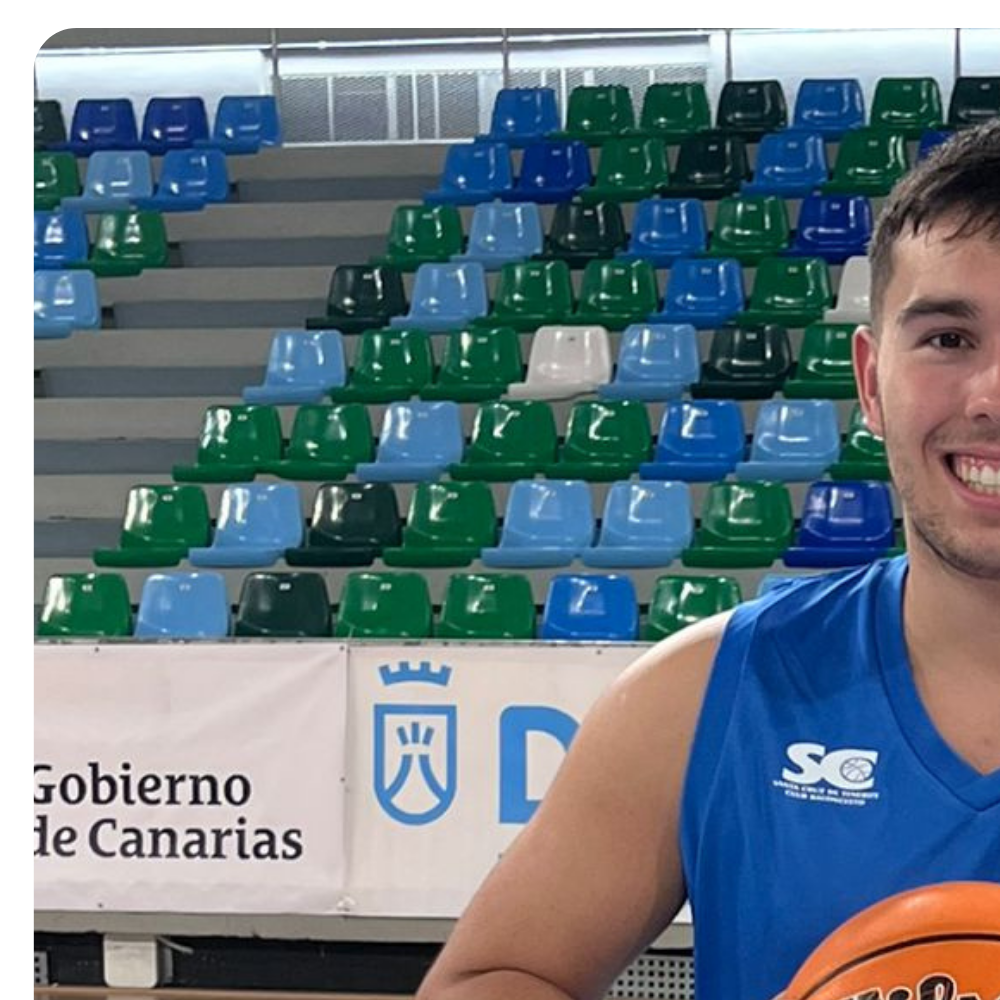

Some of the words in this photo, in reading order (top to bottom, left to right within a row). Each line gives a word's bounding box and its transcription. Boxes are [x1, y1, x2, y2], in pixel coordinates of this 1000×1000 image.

[33, 762, 251, 806] Gobierno
[782, 743, 879, 790] SC
[88, 816, 304, 861] Canarias
